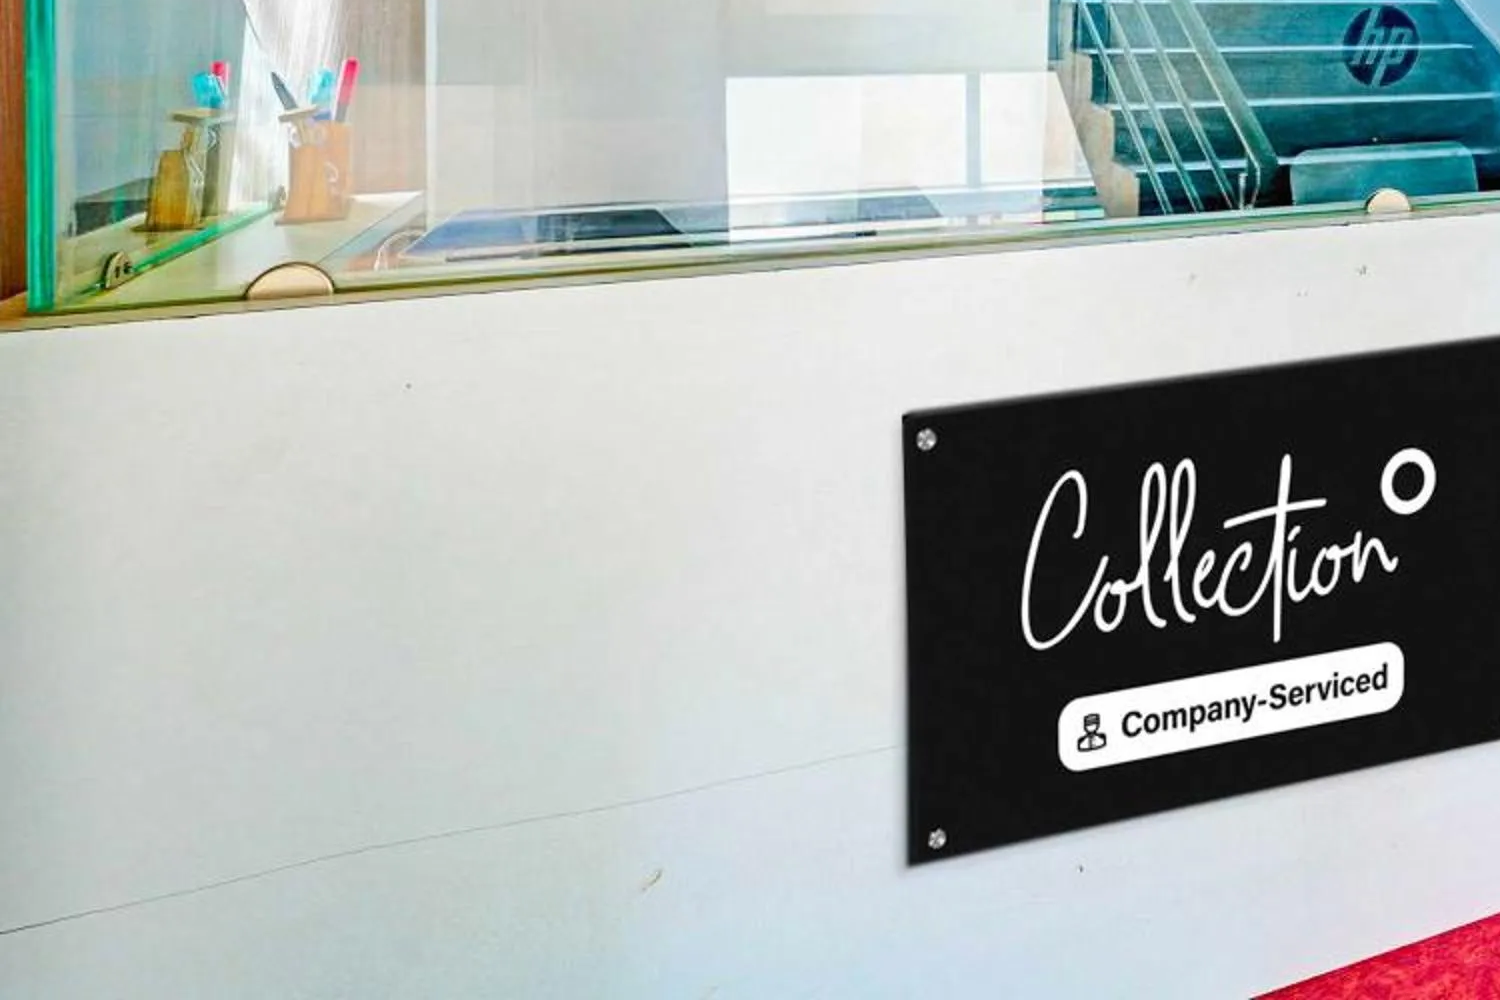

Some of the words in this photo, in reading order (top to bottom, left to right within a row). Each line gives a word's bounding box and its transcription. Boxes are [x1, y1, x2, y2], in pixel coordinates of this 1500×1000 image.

[1349, 7, 1413, 88] hp
[1022, 454, 1398, 650] Collection
[1122, 663, 1387, 738] Company-Serviced
